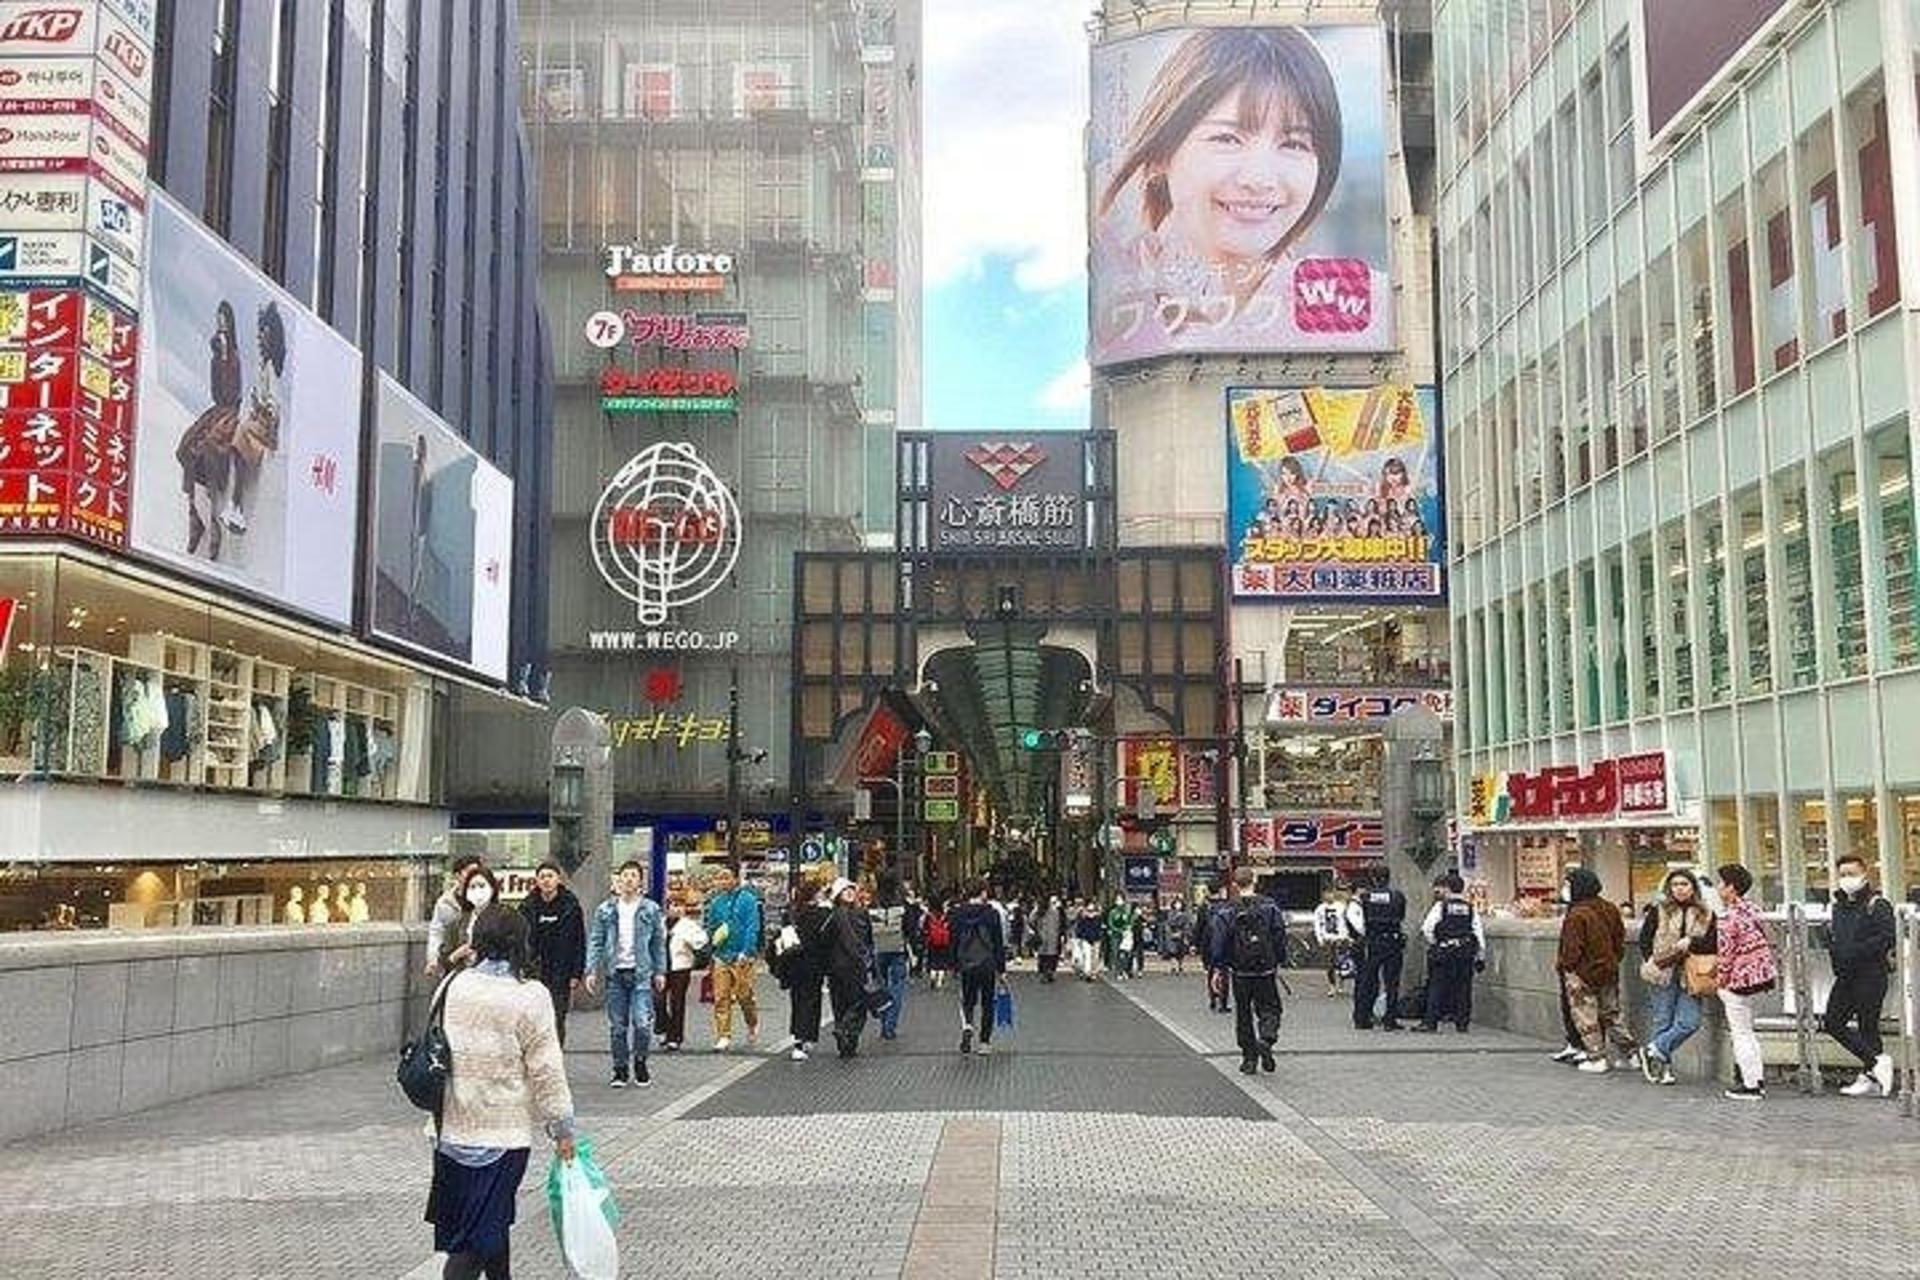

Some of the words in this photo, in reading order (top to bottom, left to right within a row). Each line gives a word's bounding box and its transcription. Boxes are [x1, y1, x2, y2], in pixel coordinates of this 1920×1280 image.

[4, 11, 79, 39] TKP
[106, 31, 146, 76] TKP
[606, 246, 732, 276] J'adore
[594, 319, 617, 341] 7F
[22, 293, 69, 503] インターネット
[108, 324, 133, 518] インターネット
[78, 391, 103, 508] コミック
[940, 495, 1076, 527] 心斎橋筋
[589, 632, 738, 649] WWW.WEGO.JP
